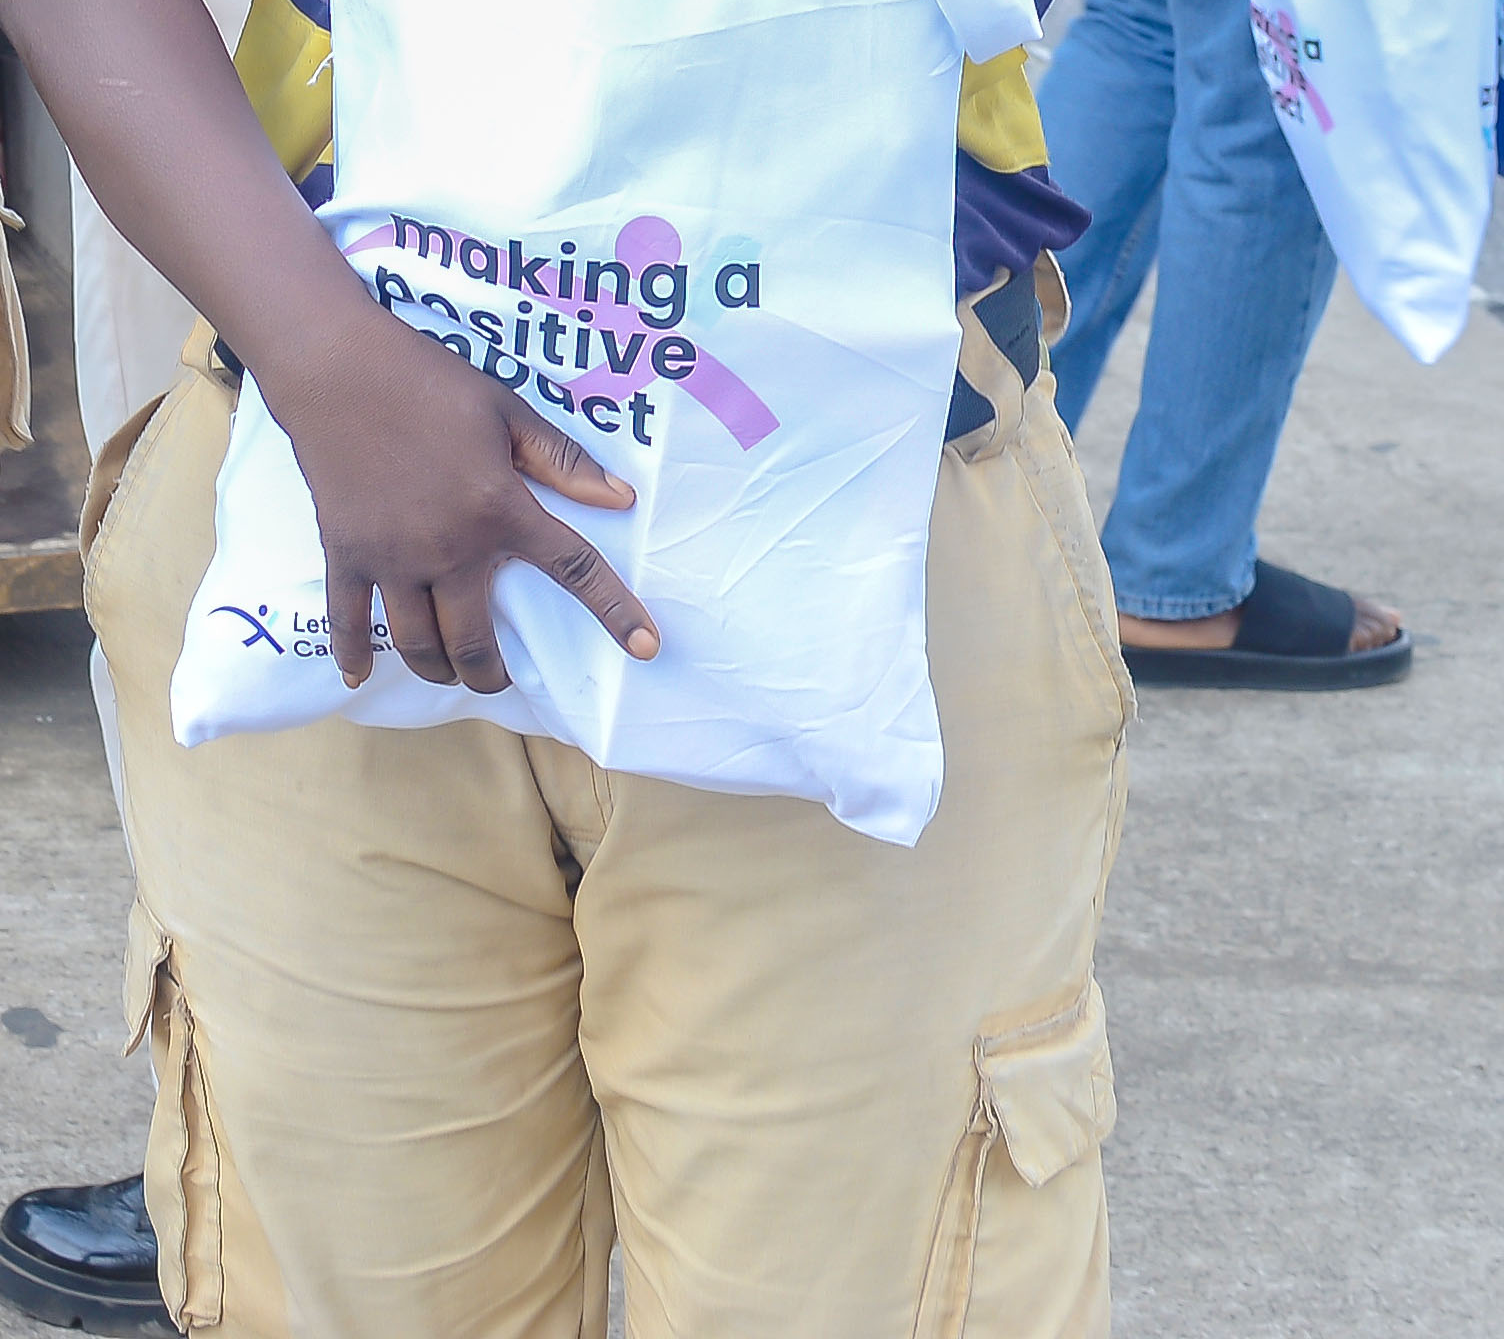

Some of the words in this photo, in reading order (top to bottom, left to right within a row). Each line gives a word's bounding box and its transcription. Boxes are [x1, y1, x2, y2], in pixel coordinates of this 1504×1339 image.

[389, 213, 688, 330] making
[715, 262, 761, 309] a
[293, 611, 331, 635] Let
